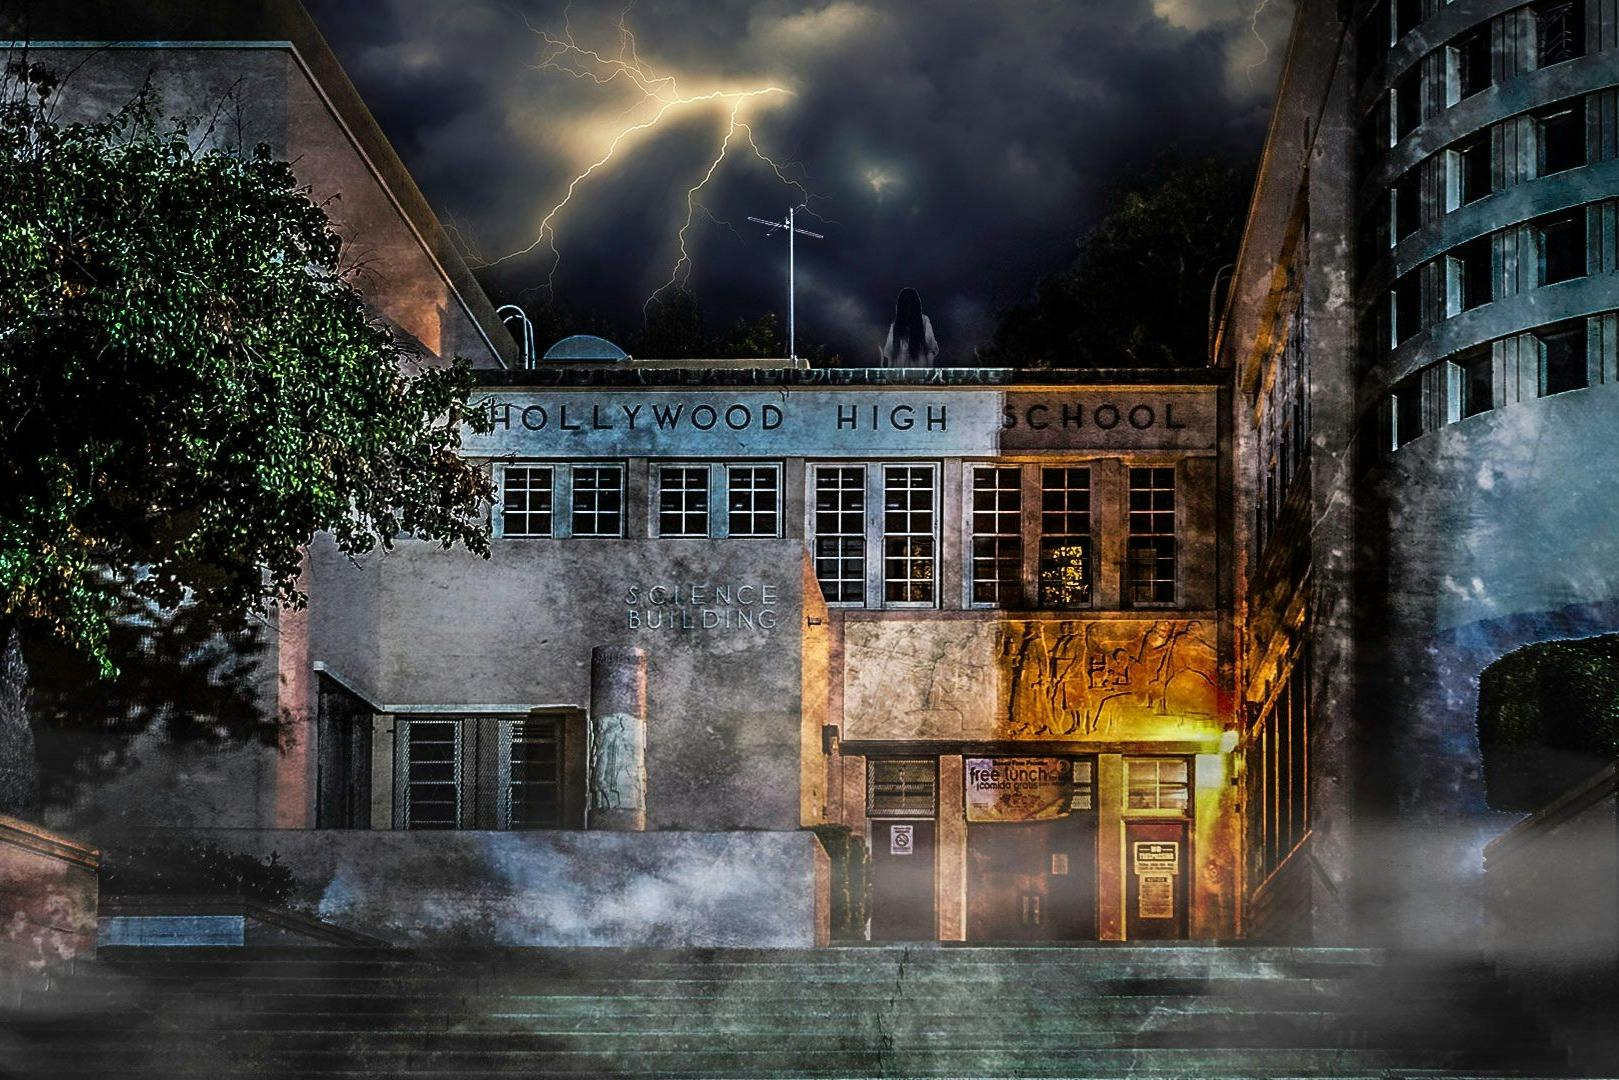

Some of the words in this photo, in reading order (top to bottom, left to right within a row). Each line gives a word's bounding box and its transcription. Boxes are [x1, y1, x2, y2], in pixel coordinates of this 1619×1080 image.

[490, 403, 785, 431] HOLLYWOOD
[836, 404, 948, 431] HIGH
[1001, 403, 1187, 431] SCHOOL
[625, 584, 777, 606] SCIENCE
[628, 609, 777, 630] BUILDING
[969, 766, 1000, 785] free
[1004, 766, 1048, 782] lunch
